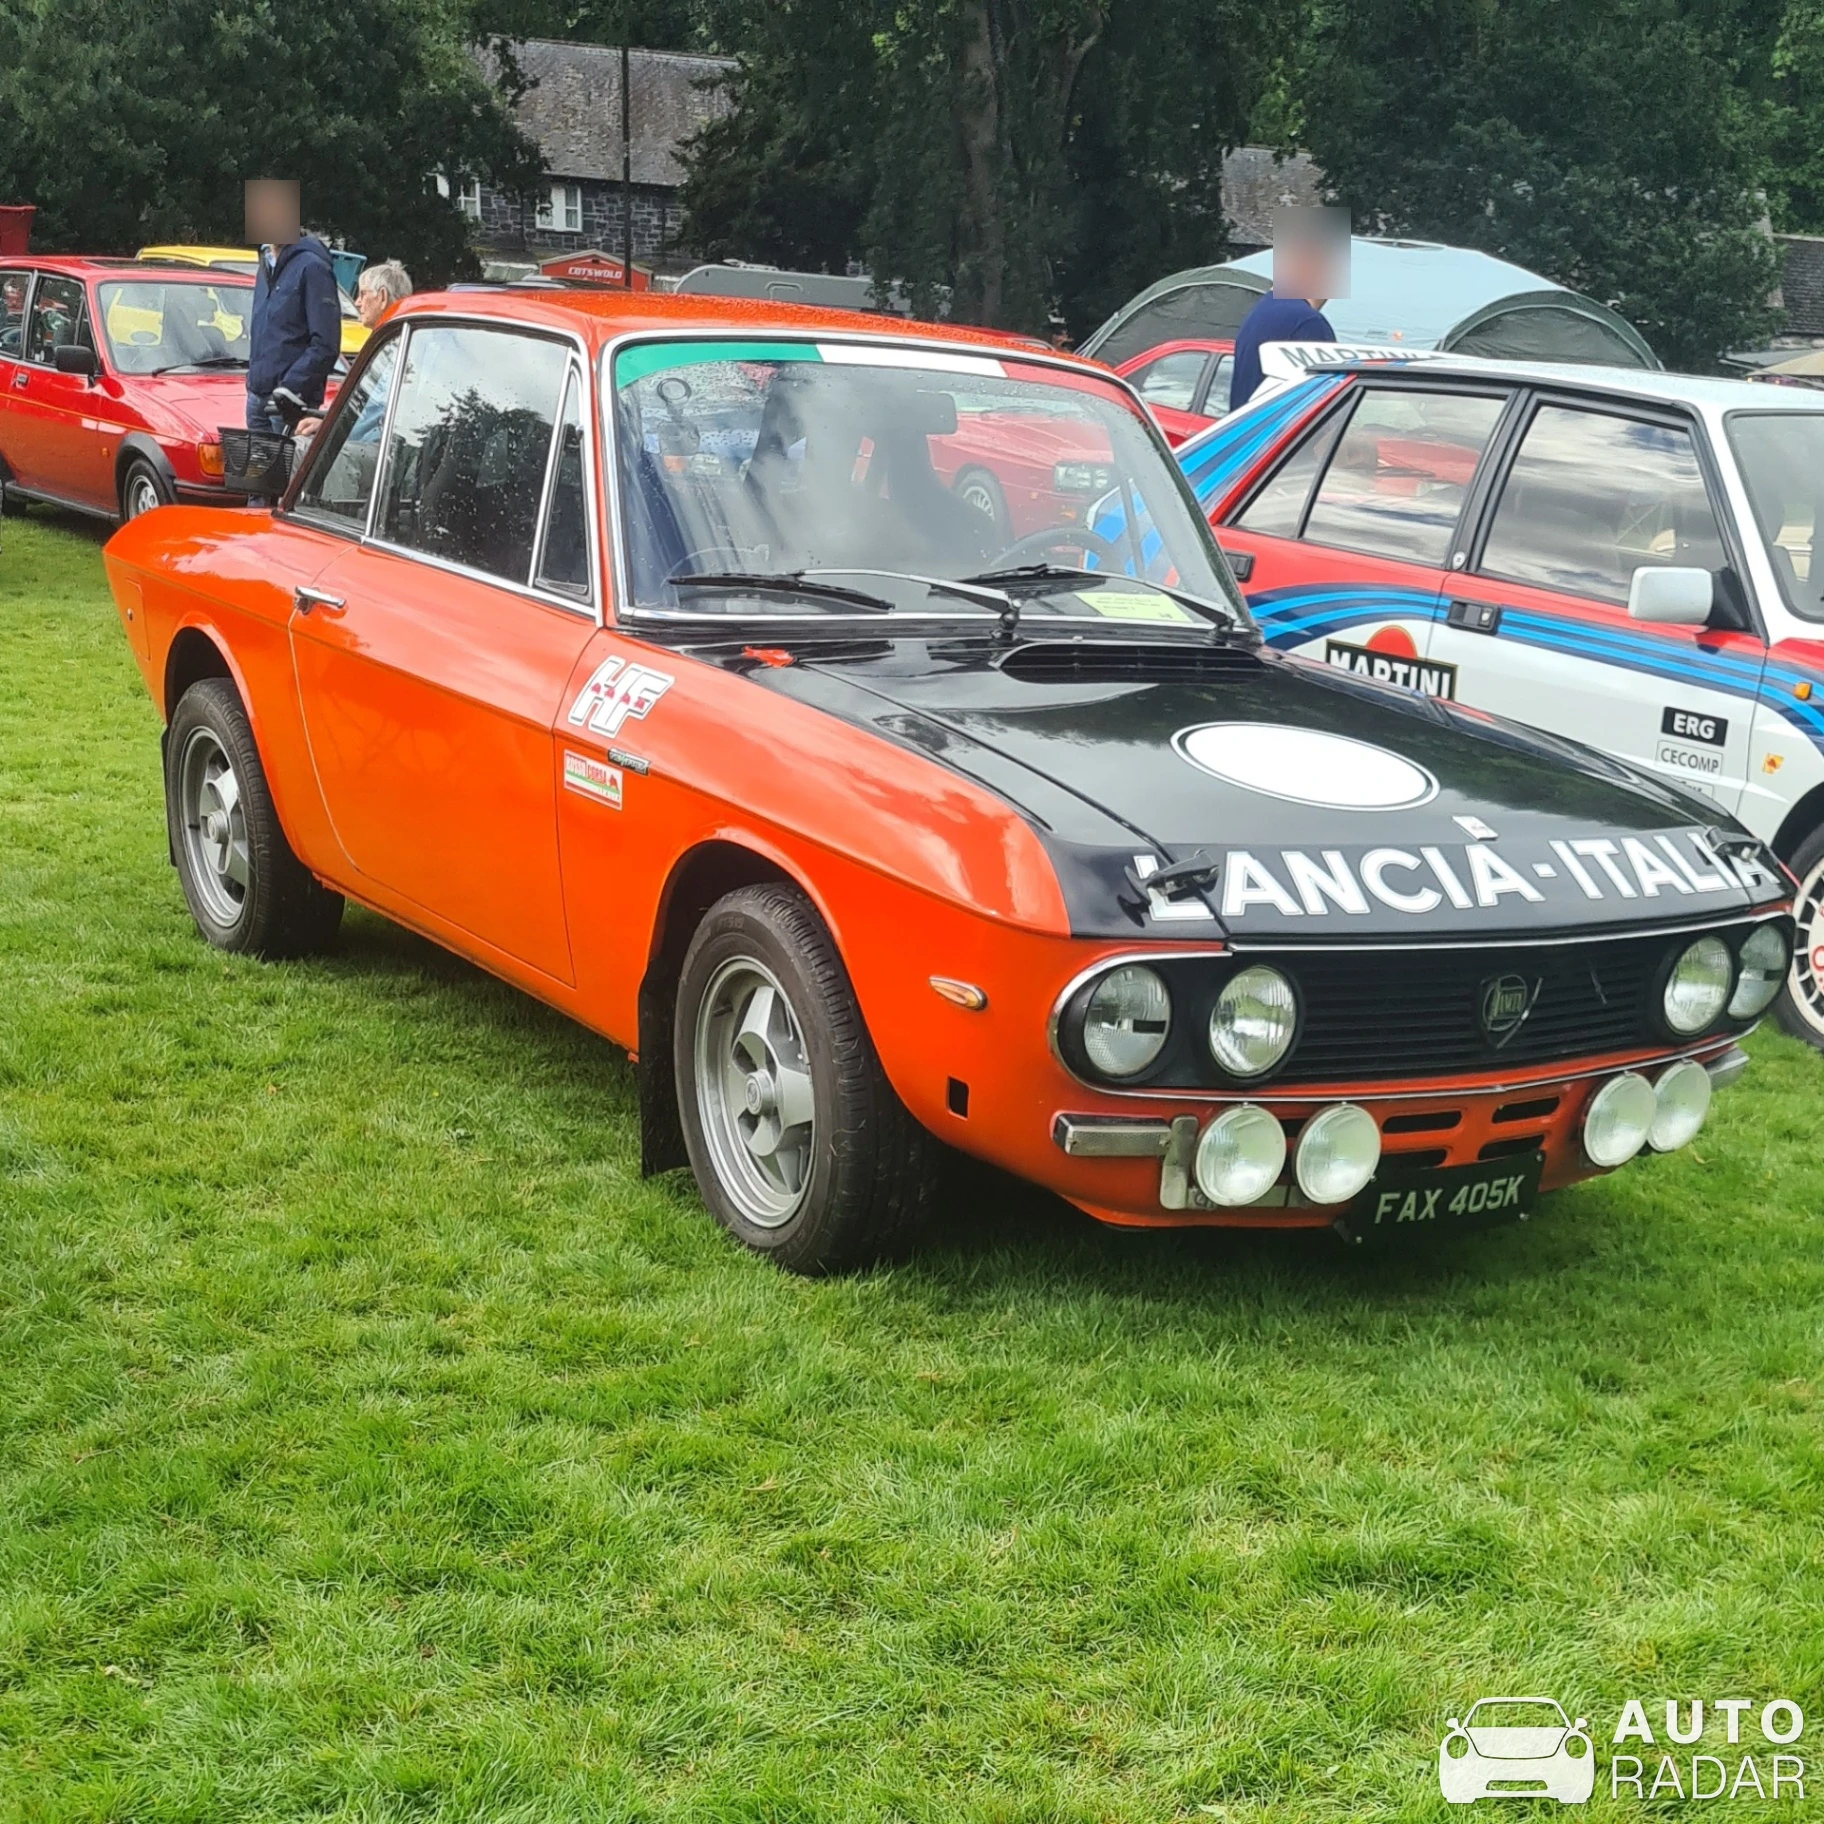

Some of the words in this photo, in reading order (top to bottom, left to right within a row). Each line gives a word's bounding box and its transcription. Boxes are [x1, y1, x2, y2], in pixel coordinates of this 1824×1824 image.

[567, 266, 623, 279] COTSWOLD
[567, 654, 676, 739] HF
[1672, 712, 1716, 740] ERG
[1660, 747, 1720, 774] CECOMP
[1374, 1188, 1443, 1225] FAX
[1448, 1174, 1526, 1216] 405K
